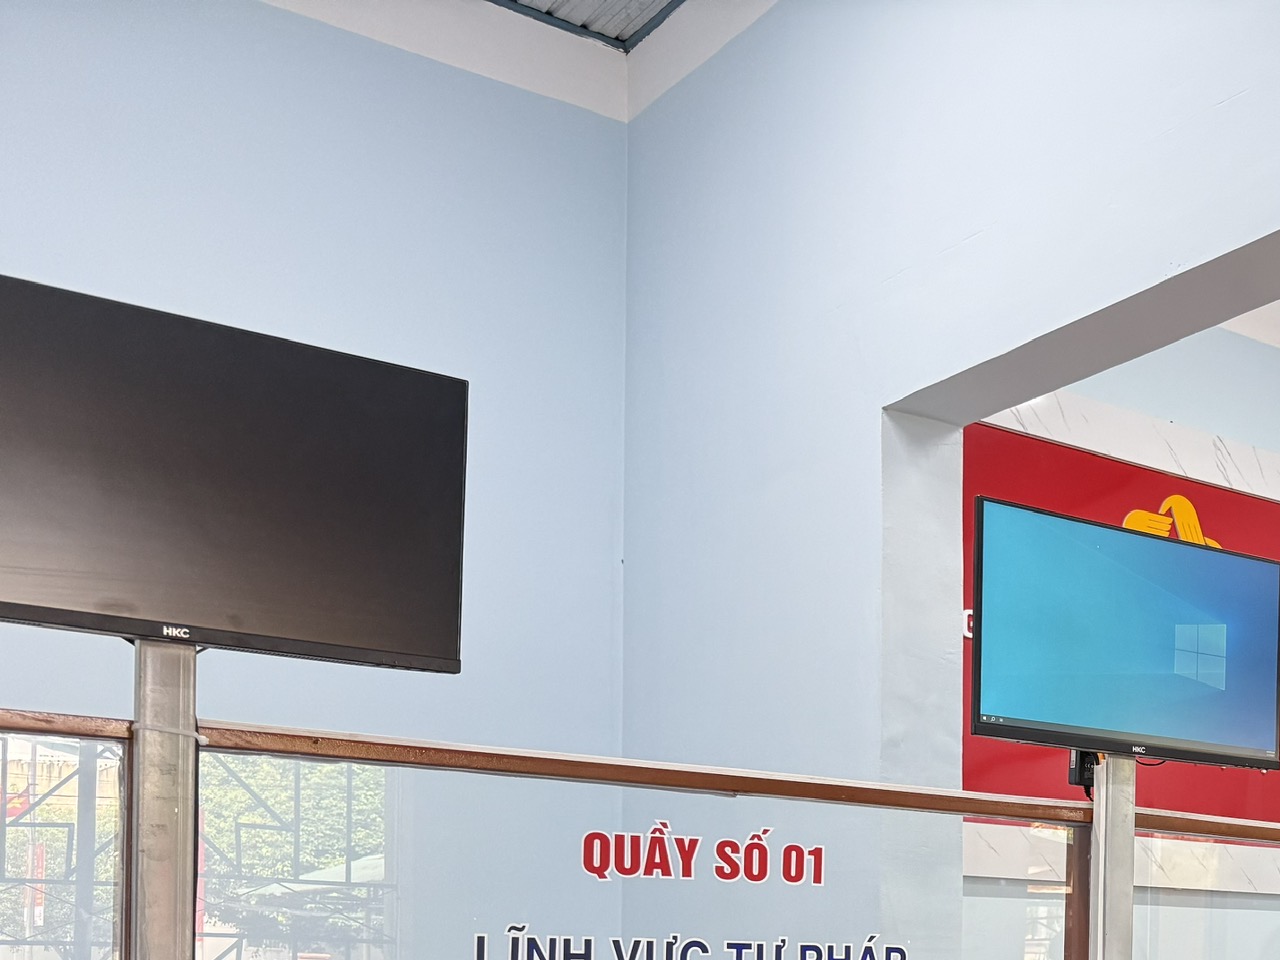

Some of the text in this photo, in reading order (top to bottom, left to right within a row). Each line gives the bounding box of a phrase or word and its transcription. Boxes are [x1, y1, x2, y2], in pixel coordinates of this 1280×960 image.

[162, 625, 190, 638] HKC
[1132, 746, 1146, 754] HKC
[582, 820, 824, 886] QUẦY SỐ 01
